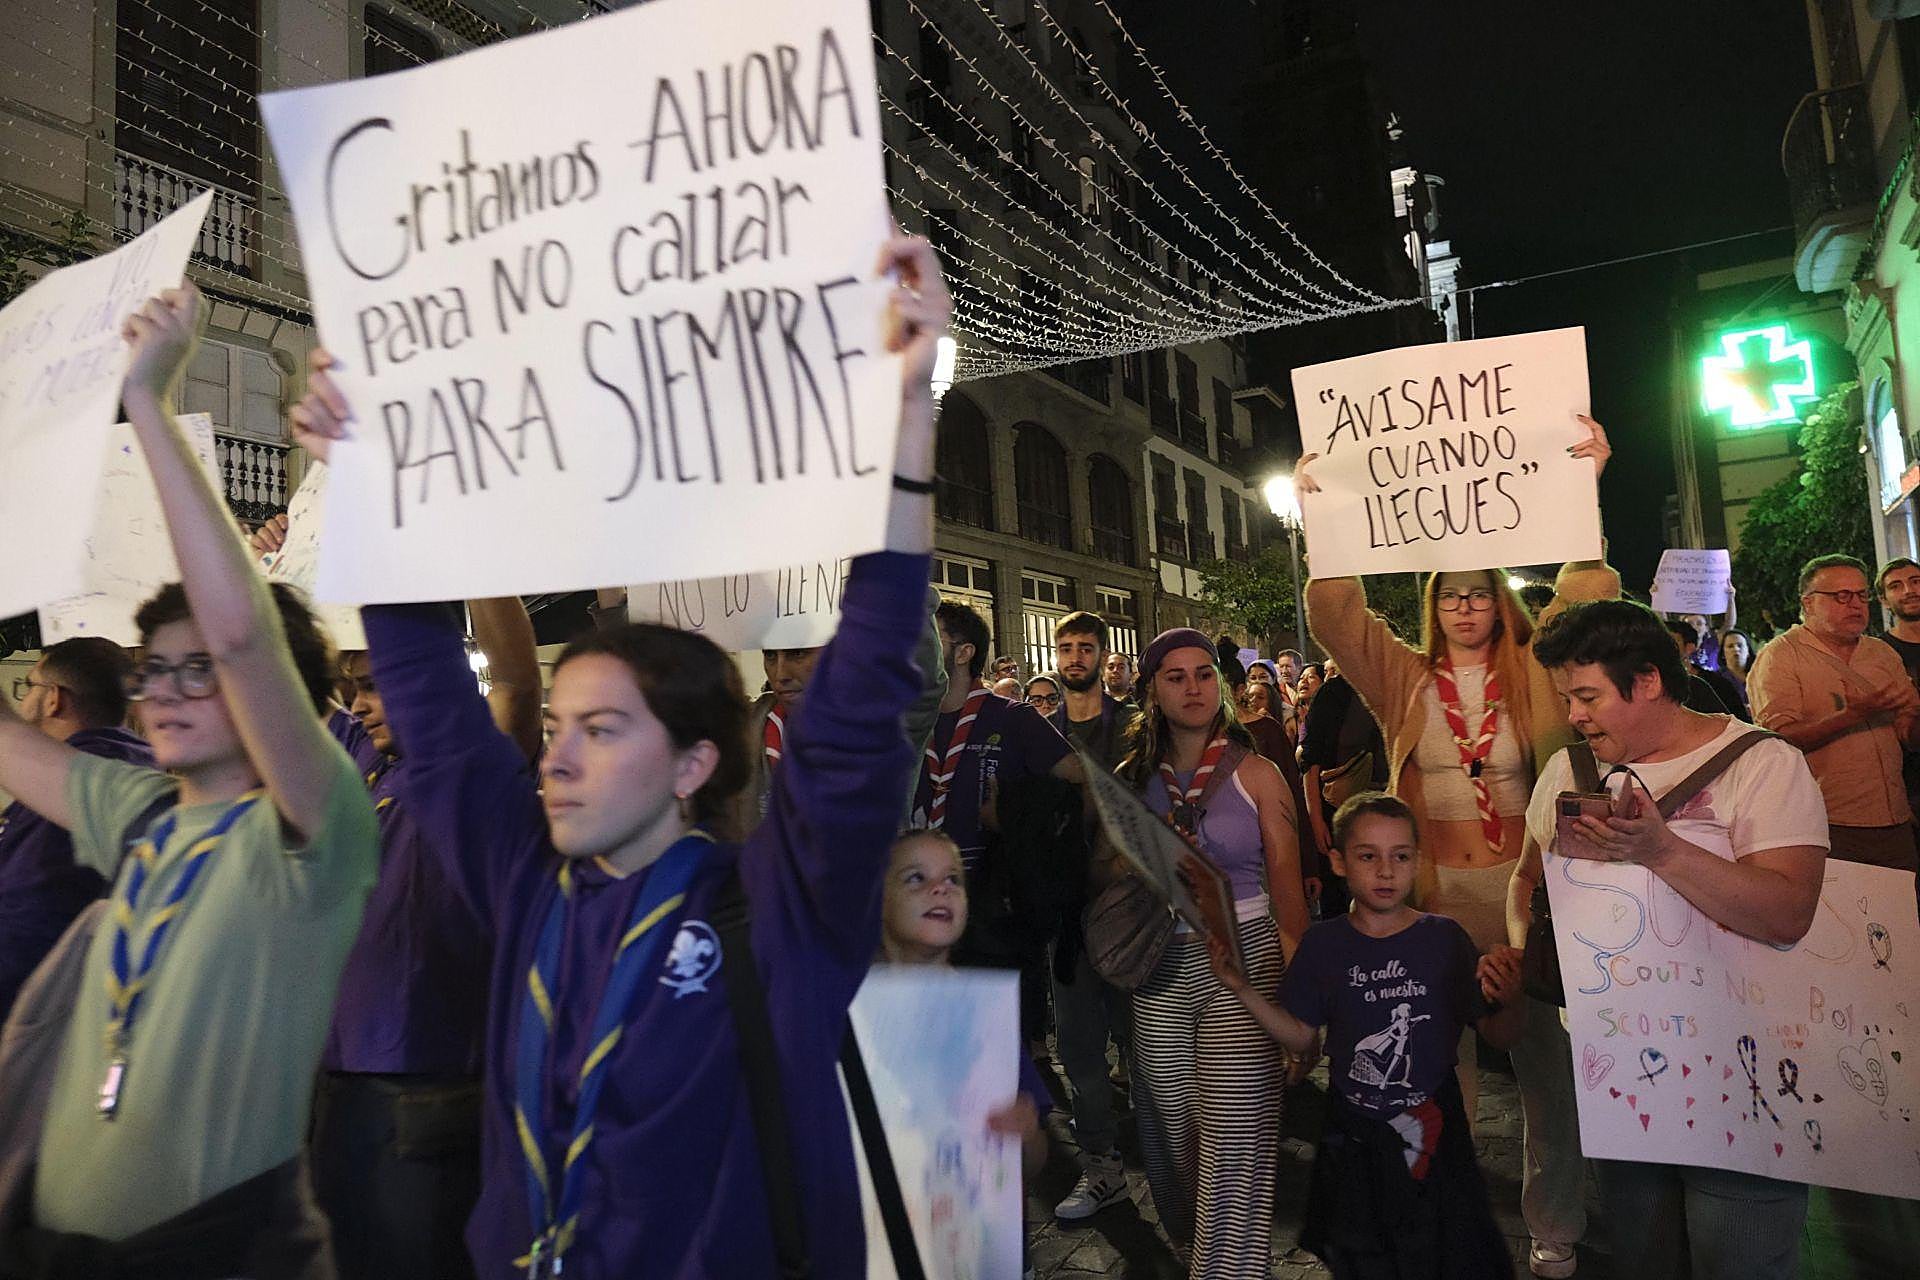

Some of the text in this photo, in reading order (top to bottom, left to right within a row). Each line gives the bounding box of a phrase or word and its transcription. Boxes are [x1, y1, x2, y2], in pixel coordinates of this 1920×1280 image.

[325, 116, 599, 281] Gritamos
[628, 26, 861, 184] AHORA
[357, 175, 813, 377] para NO callar
[381, 366, 566, 529] PARA
[582, 276, 878, 502] SIEMPRE
[1319, 363, 1516, 455] "AVISAME
[1368, 425, 1516, 488] CUANDO
[1364, 461, 1539, 549] LLEGUES"
[1348, 959, 1407, 987] La calle
[1363, 979, 1428, 1002] es nuestra
[1597, 1007, 1698, 1038] SCOUTS
